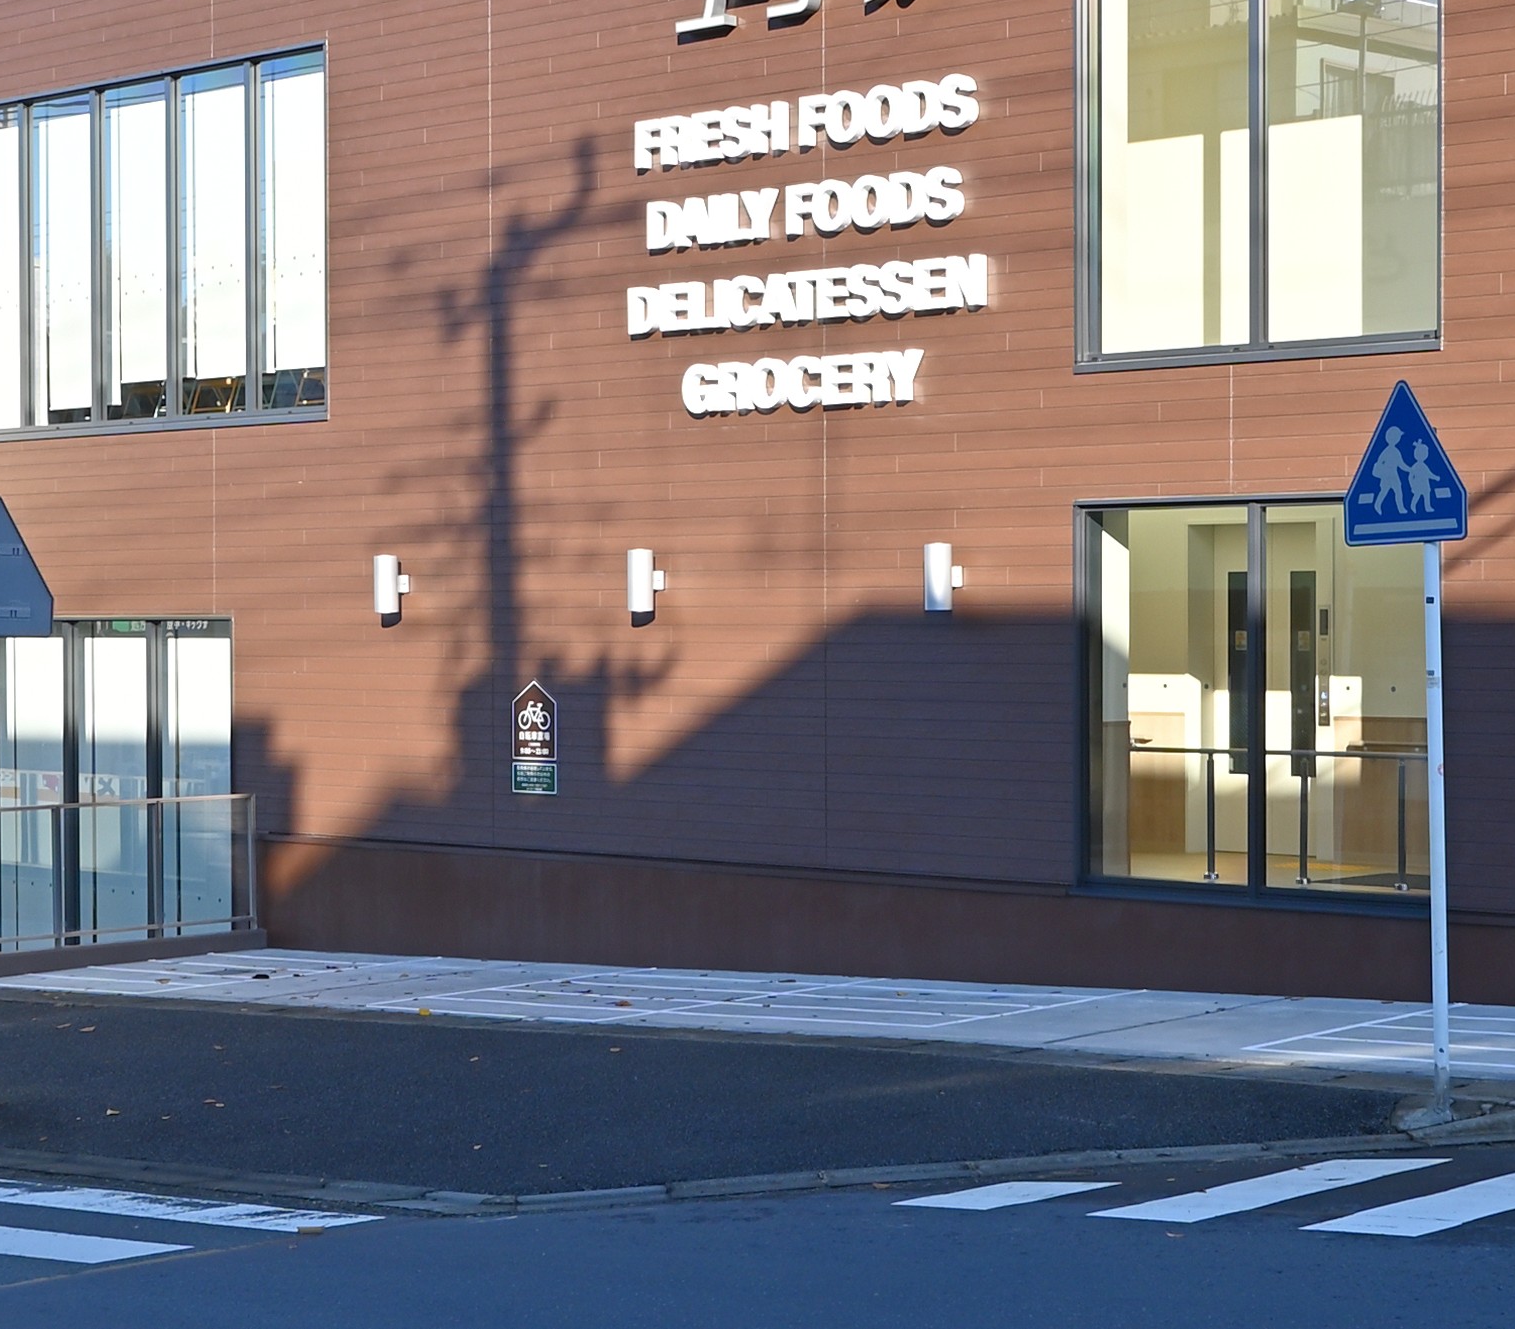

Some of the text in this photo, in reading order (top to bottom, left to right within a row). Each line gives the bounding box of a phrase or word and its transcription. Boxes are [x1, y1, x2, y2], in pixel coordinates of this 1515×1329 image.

[634, 73, 980, 171] FRESH FOODS
[646, 166, 965, 251] DAILY FOODS
[627, 253, 988, 338] DELICATESSEN
[681, 348, 925, 416] GROCERY
